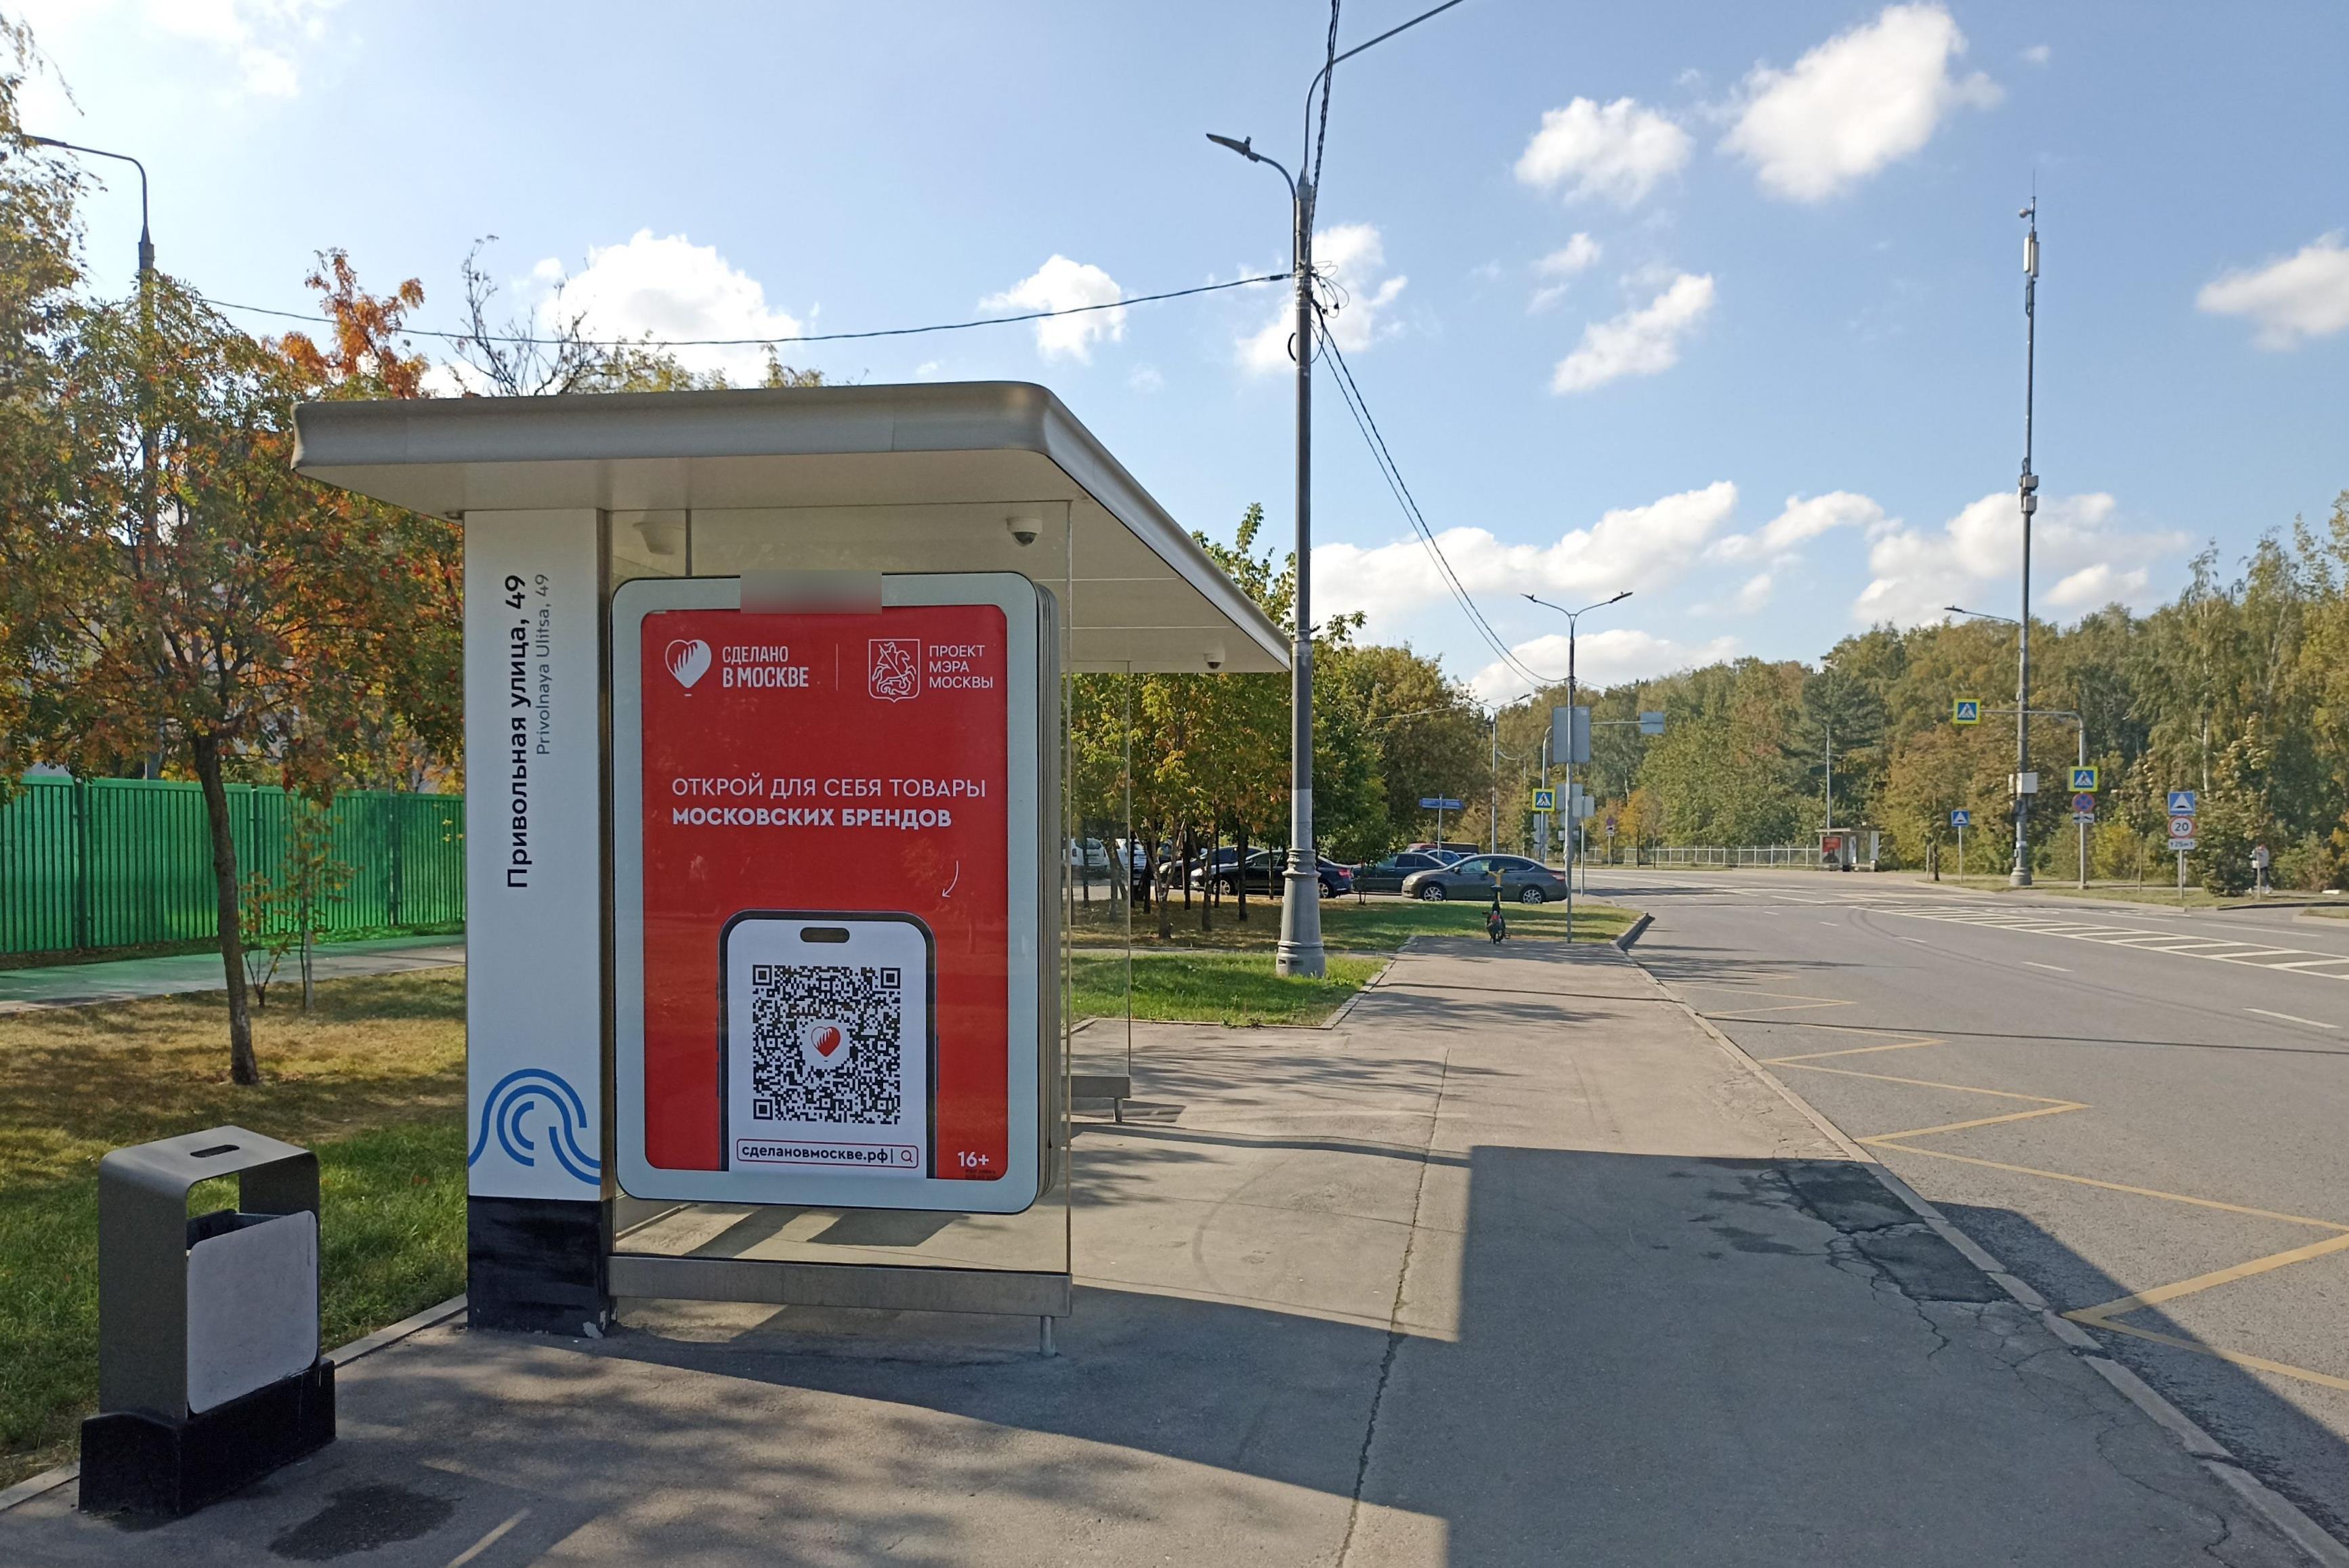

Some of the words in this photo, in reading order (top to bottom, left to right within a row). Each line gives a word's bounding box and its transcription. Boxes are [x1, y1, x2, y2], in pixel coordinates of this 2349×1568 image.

[504, 574, 526, 610] 49
[534, 574, 549, 597] 49
[535, 603, 551, 658] Ulitsa,
[510, 618, 532, 708] улица,
[722, 645, 788, 665] СДЕЛАНО
[929, 645, 986, 658] ПРОЕКТ
[929, 660, 969, 673] МЭРА
[929, 676, 993, 689] МОСКВЫ
[535, 664, 553, 755] Privolnaya
[672, 772, 763, 796] ОТКРОЙ
[770, 778, 816, 799] ДЛЯ
[824, 778, 881, 797] СЕБЯ
[889, 779, 986, 797] ТОВАРЫ
[507, 717, 533, 888] Привольная
[673, 807, 834, 826] МОСКОВСКИХ
[842, 809, 952, 830] БРЕНДОВ
[2174, 822, 2189, 832] 20
[958, 1151, 990, 1168] 16+
